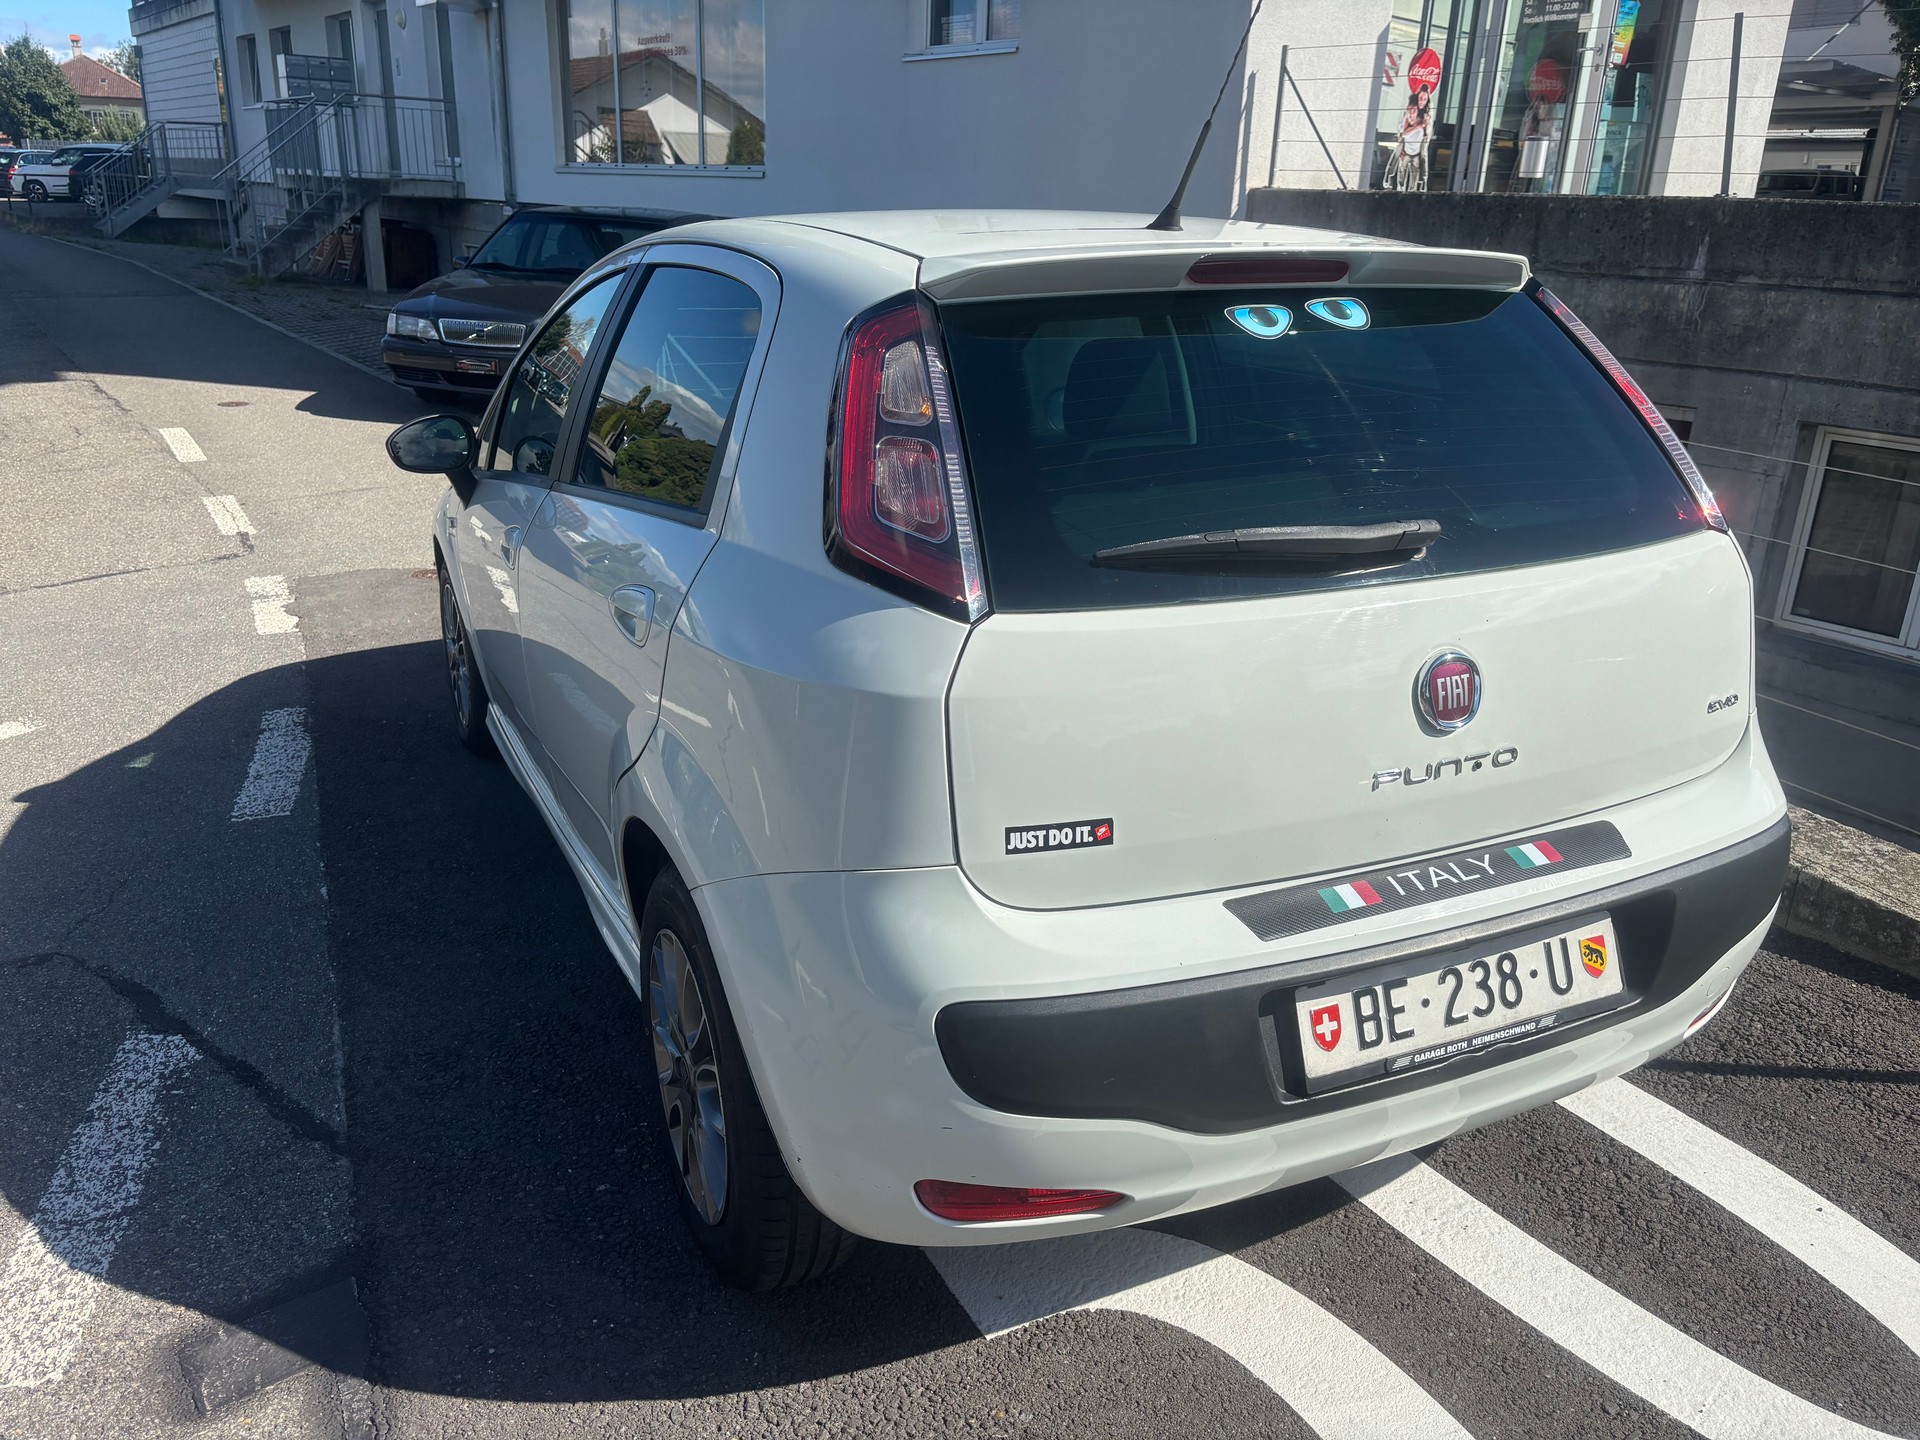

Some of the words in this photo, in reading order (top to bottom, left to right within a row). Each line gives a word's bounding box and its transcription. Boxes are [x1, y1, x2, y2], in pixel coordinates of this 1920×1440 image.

[1522, 15, 1544, 24] Herzlich
[1544, 13, 1578, 22] Willkommen
[1437, 673, 1470, 711] FIAT
[1371, 746, 1519, 793] PUNTO
[1007, 829, 1047, 850] JUST
[1048, 827, 1073, 847] DO
[1075, 825, 1094, 844] IT.
[1386, 853, 1495, 896] ITALY
[1414, 1047, 1446, 1062] GARAGE
[1446, 1041, 1468, 1054] ROTH
[1472, 1022, 1536, 1047] HEIMENSCHWAND
